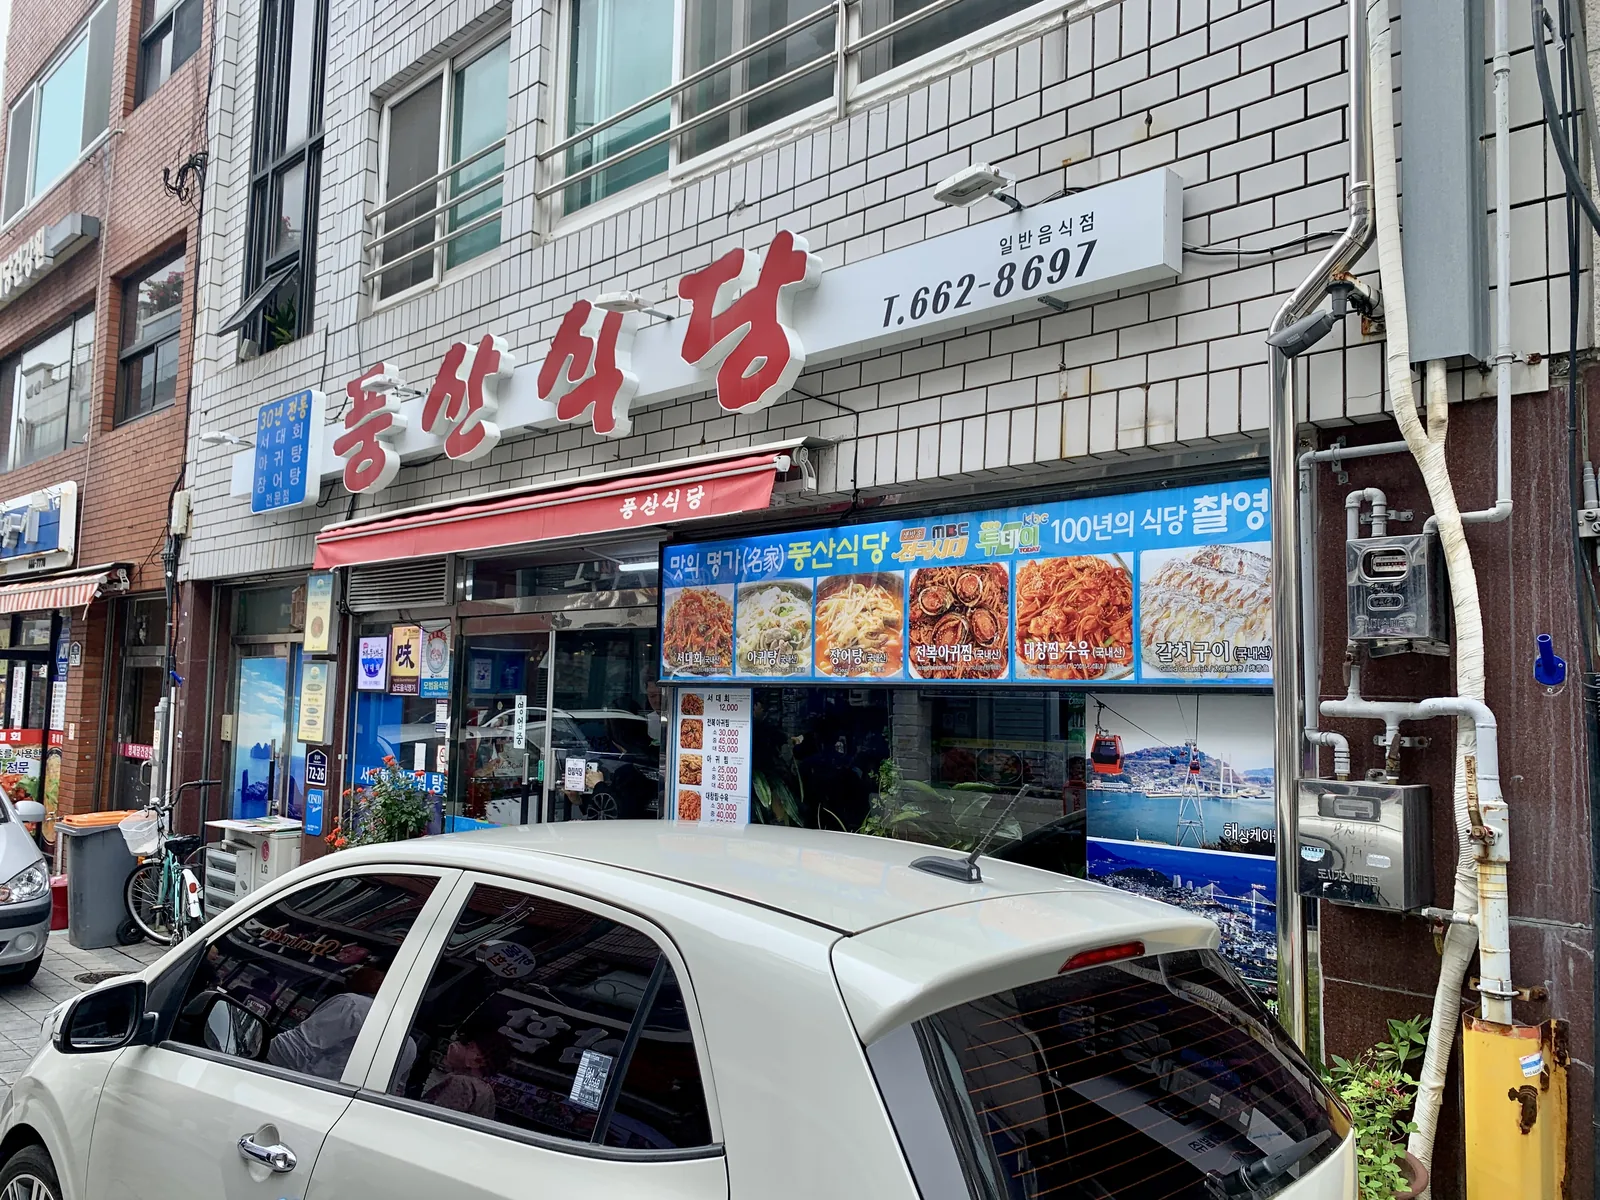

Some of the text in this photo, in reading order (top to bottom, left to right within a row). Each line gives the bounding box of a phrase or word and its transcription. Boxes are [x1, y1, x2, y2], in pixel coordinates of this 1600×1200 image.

[999, 211, 1095, 256] 일반음식점
[882, 239, 1098, 328] T.662-8697
[333, 229, 810, 493] 풍산식당
[260, 394, 309, 430] 30년 전통
[260, 422, 304, 449] 서대회
[258, 444, 303, 471] 아귀탕
[257, 467, 301, 494] 장어탕
[266, 489, 290, 507] 전문점
[619, 485, 705, 520] 풍산식당
[1023, 512, 1049, 527] kbc
[1051, 488, 1269, 544] 100년의 식당 촬영
[932, 523, 969, 539] MBC
[976, 523, 1040, 556] 투데이
[670, 553, 700, 580] 맛의
[787, 531, 890, 571] 풍산식당
[892, 537, 968, 562] 전국시대
[395, 638, 415, 669] 味
[677, 651, 702, 666] 서대회
[747, 650, 777, 666] 아귀탕
[829, 648, 863, 664] 장어탕
[915, 643, 1001, 663] 전복아귀찜 (국내산)
[1092, 646, 1126, 659] (국내산)
[1155, 640, 1272, 663] 갈치구이 (국내산)
[424, 681, 448, 690] 모범음식점
[719, 703, 738, 711] 12,000
[718, 729, 739, 737] 30,000
[718, 737, 739, 745] 45,000
[718, 745, 739, 753] 55,000
[7, 762, 29, 773] 전문
[308, 766, 325, 781] 72-26
[717, 765, 738, 774] 25,000
[717, 774, 738, 782] 35,000
[717, 782, 738, 791] 45,000
[716, 803, 737, 811] 30,000
[260, 863, 269, 874] LG
